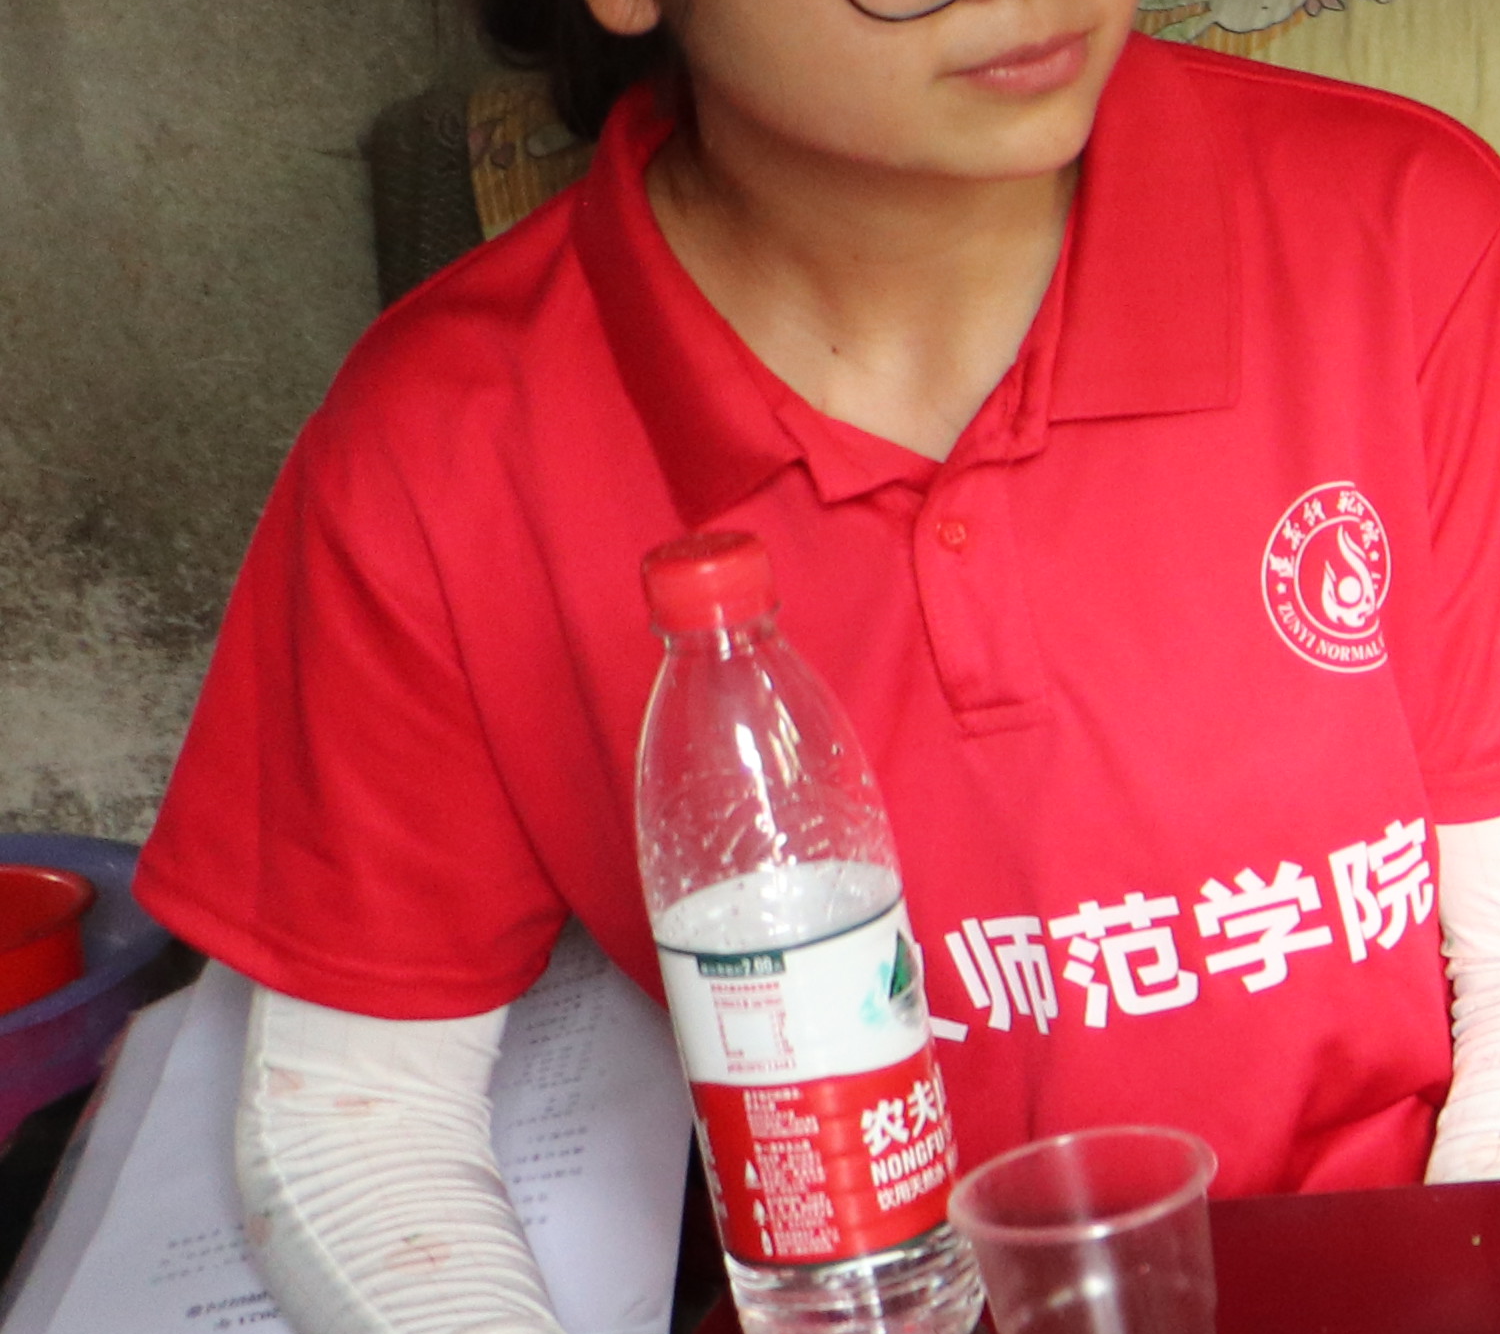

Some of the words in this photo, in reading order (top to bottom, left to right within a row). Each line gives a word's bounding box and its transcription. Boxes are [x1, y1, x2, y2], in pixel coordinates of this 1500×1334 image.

[1276, 600, 1317, 650] ZUNYI
[1315, 639, 1381, 662] NORMAL
[926, 816, 1434, 1043] 师范学院
[869, 1126, 947, 1187] NONGFU
